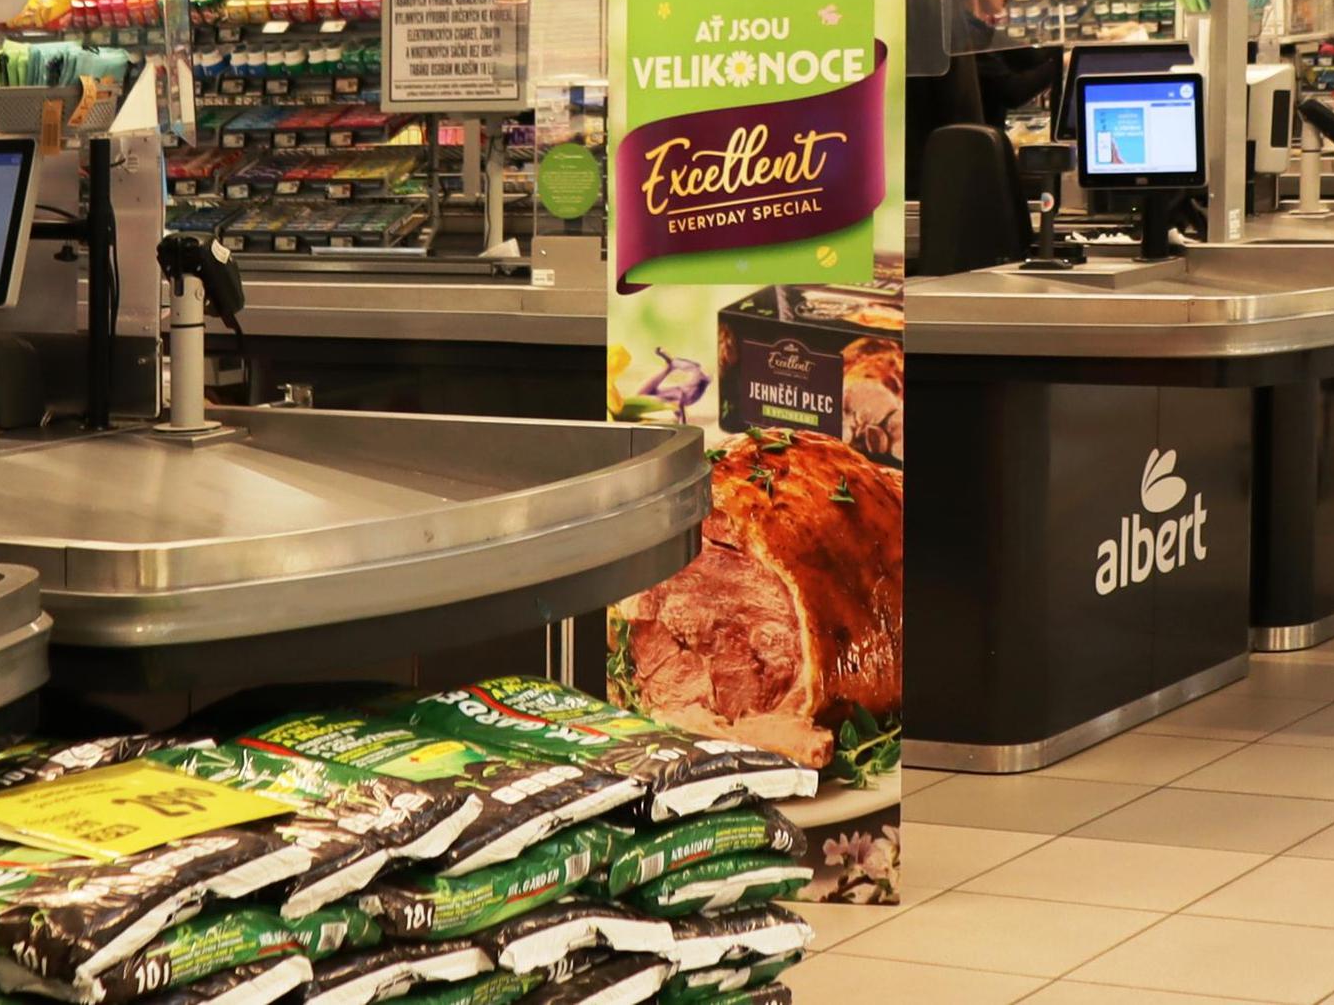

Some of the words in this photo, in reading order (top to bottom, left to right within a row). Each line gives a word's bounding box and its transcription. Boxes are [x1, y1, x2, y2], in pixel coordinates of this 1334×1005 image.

[695, 14, 724, 43] AŤ
[729, 17, 790, 42] JSOU
[632, 48, 865, 90] VELIKONOCE
[641, 124, 847, 216] Excellent
[668, 208, 747, 234] EVERYDAY
[753, 198, 823, 223] SPECIAL
[749, 381, 798, 408] JEHNĚČÍ
[802, 391, 834, 414] PLEC
[1095, 492, 1208, 596] albert
